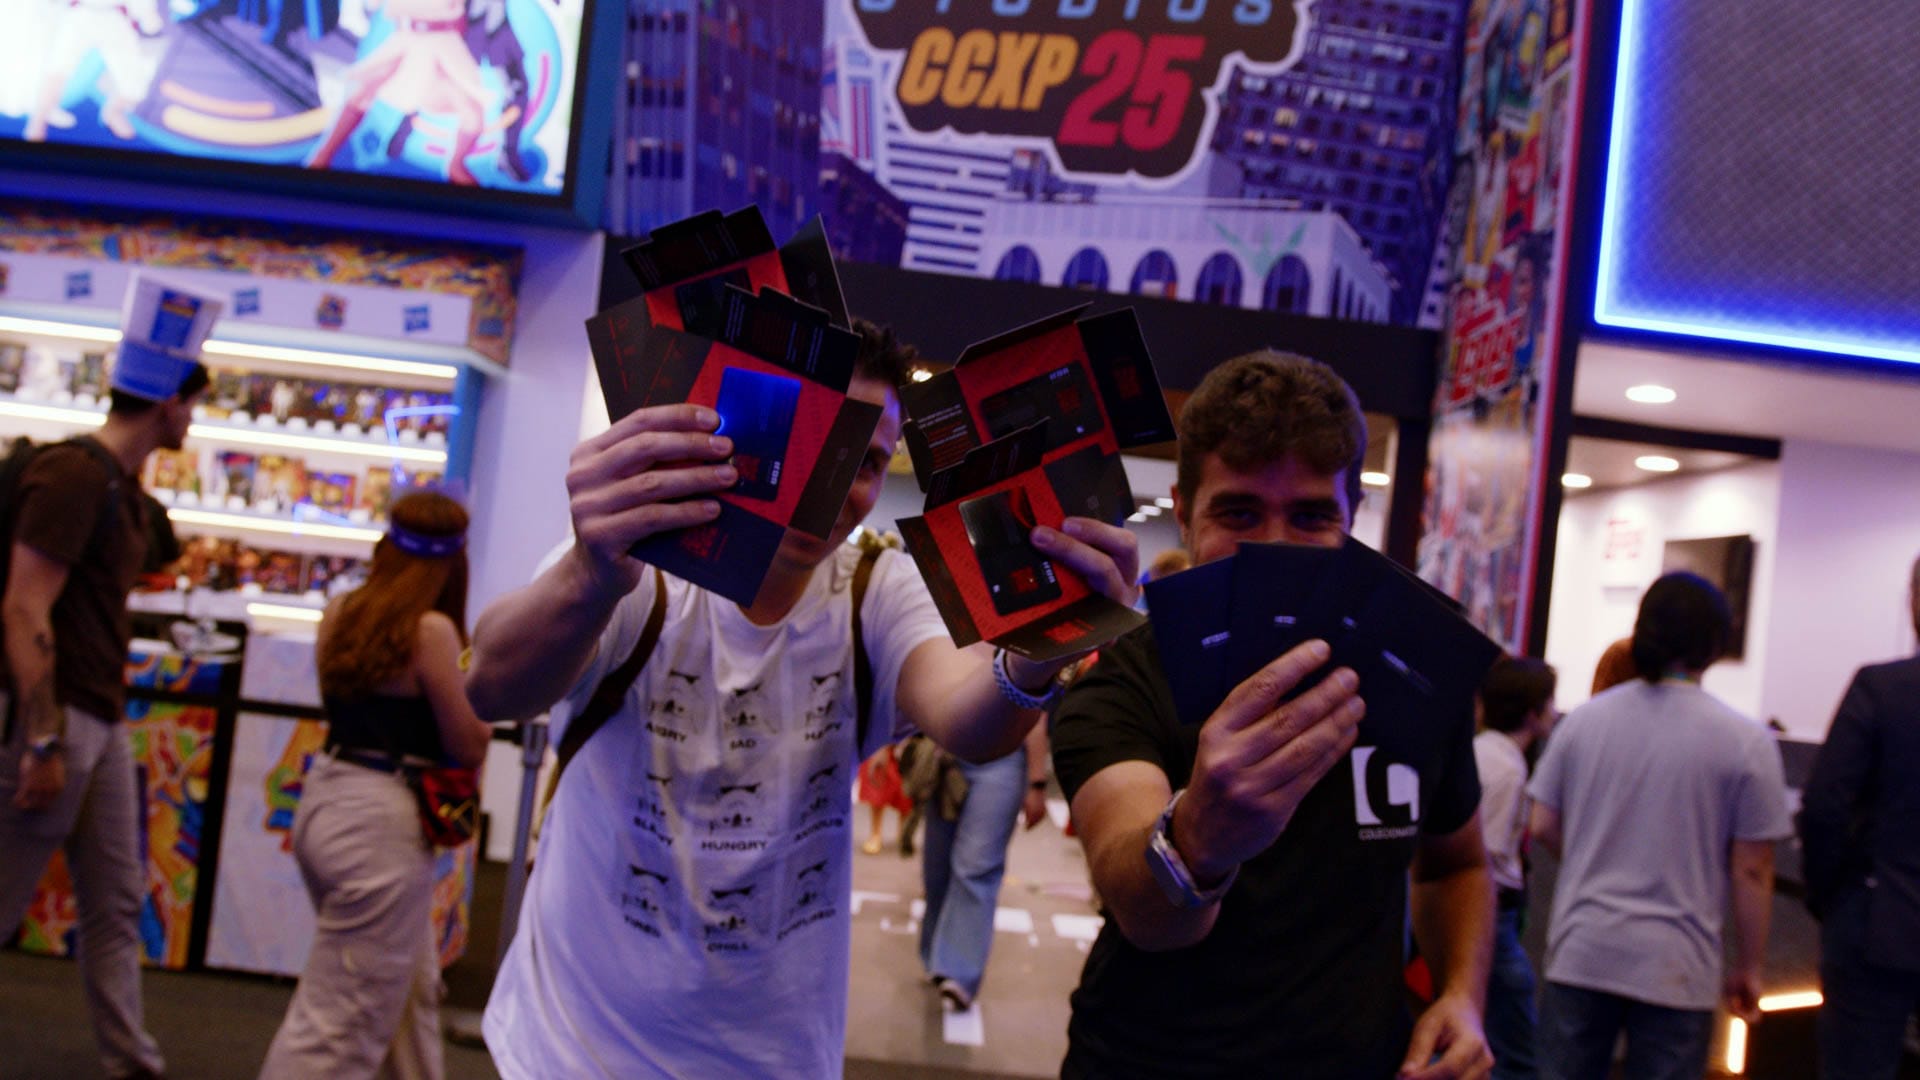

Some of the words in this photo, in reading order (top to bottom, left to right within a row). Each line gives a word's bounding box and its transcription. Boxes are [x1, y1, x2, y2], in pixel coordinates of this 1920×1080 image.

[899, 27, 1078, 112] CCXP
[1057, 30, 1206, 151] 25
[701, 840, 768, 852] HUNGRY
